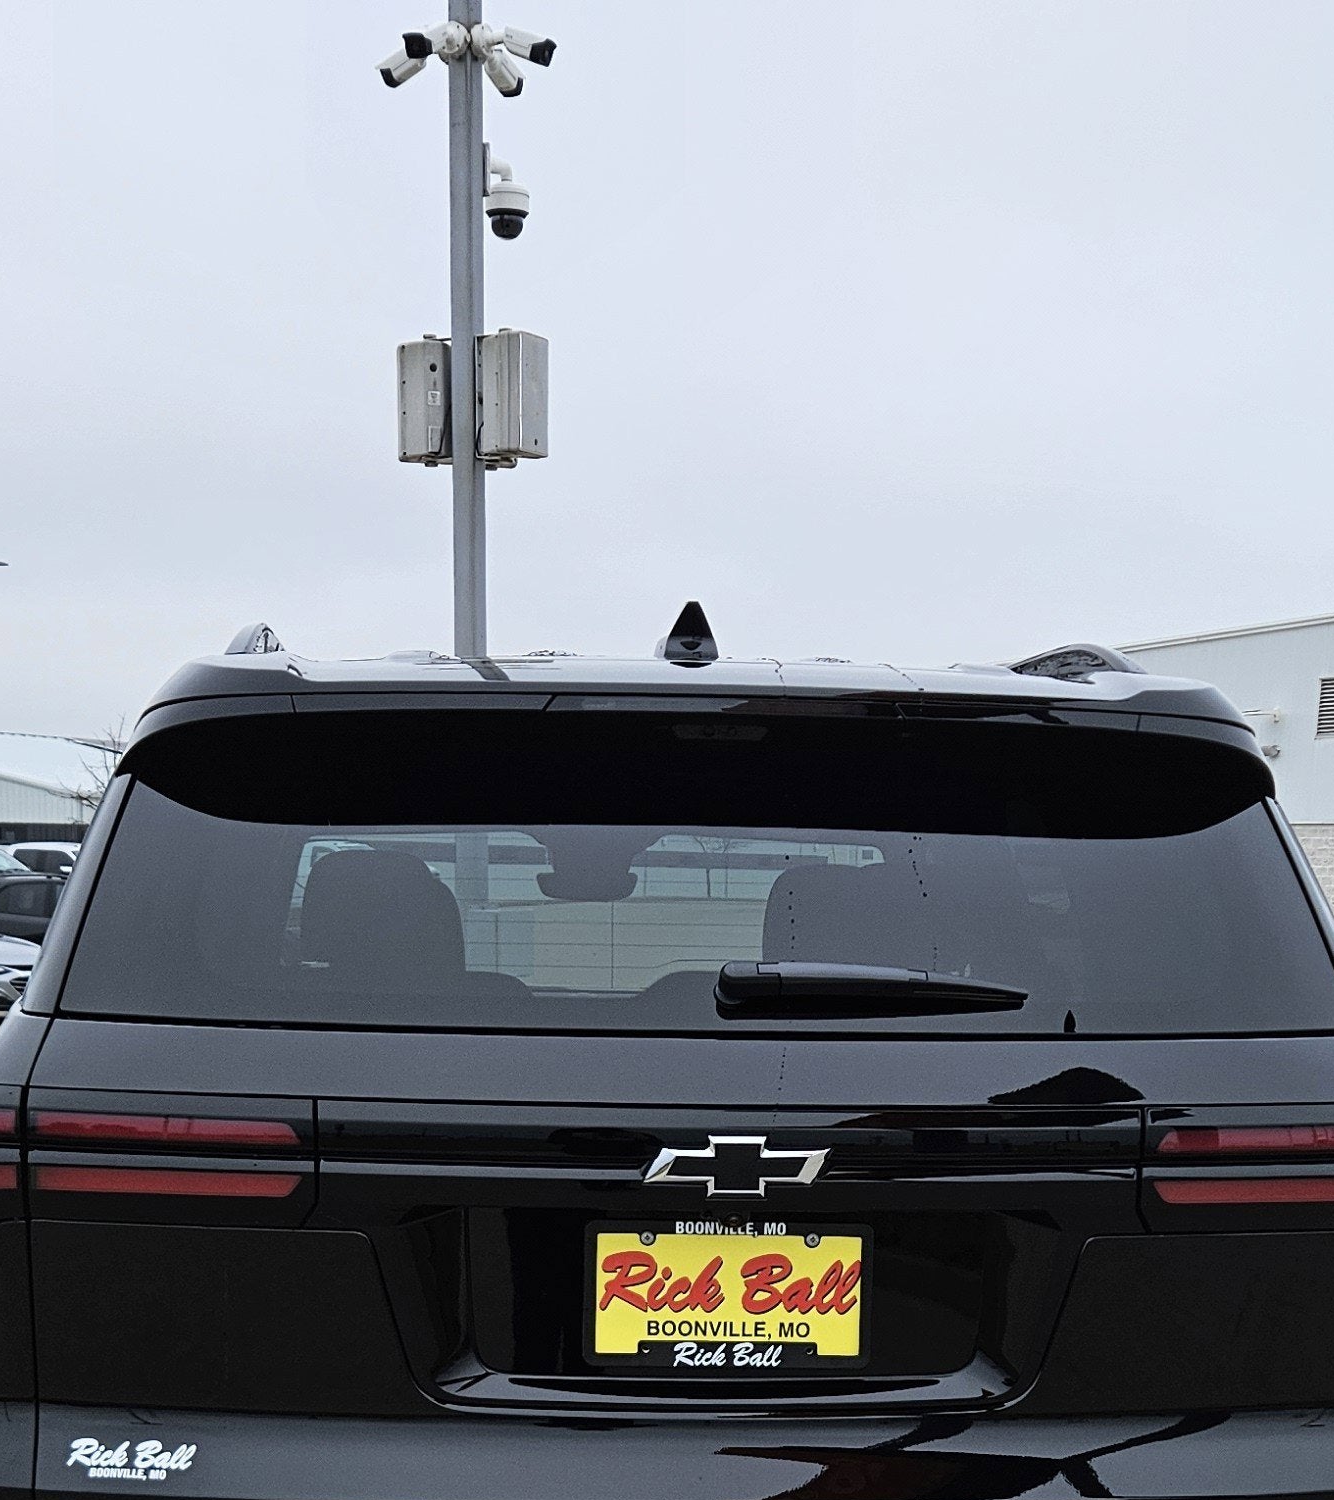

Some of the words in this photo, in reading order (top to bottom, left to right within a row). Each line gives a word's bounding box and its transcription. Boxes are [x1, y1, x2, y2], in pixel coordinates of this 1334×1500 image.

[675, 1221, 759, 1238] BOONVILLE,
[763, 1222, 787, 1236] MO
[598, 1250, 725, 1313] Rick
[740, 1253, 862, 1316] Ball
[647, 1320, 772, 1340] BOONVILLE,
[778, 1322, 811, 1338] MO
[673, 1341, 727, 1367] Rick
[732, 1342, 783, 1368] Ball
[66, 1437, 130, 1468] Rick
[134, 1440, 197, 1471] Ball
[88, 1467, 147, 1480] BOONVILLE,
[148, 1468, 167, 1480] MO
